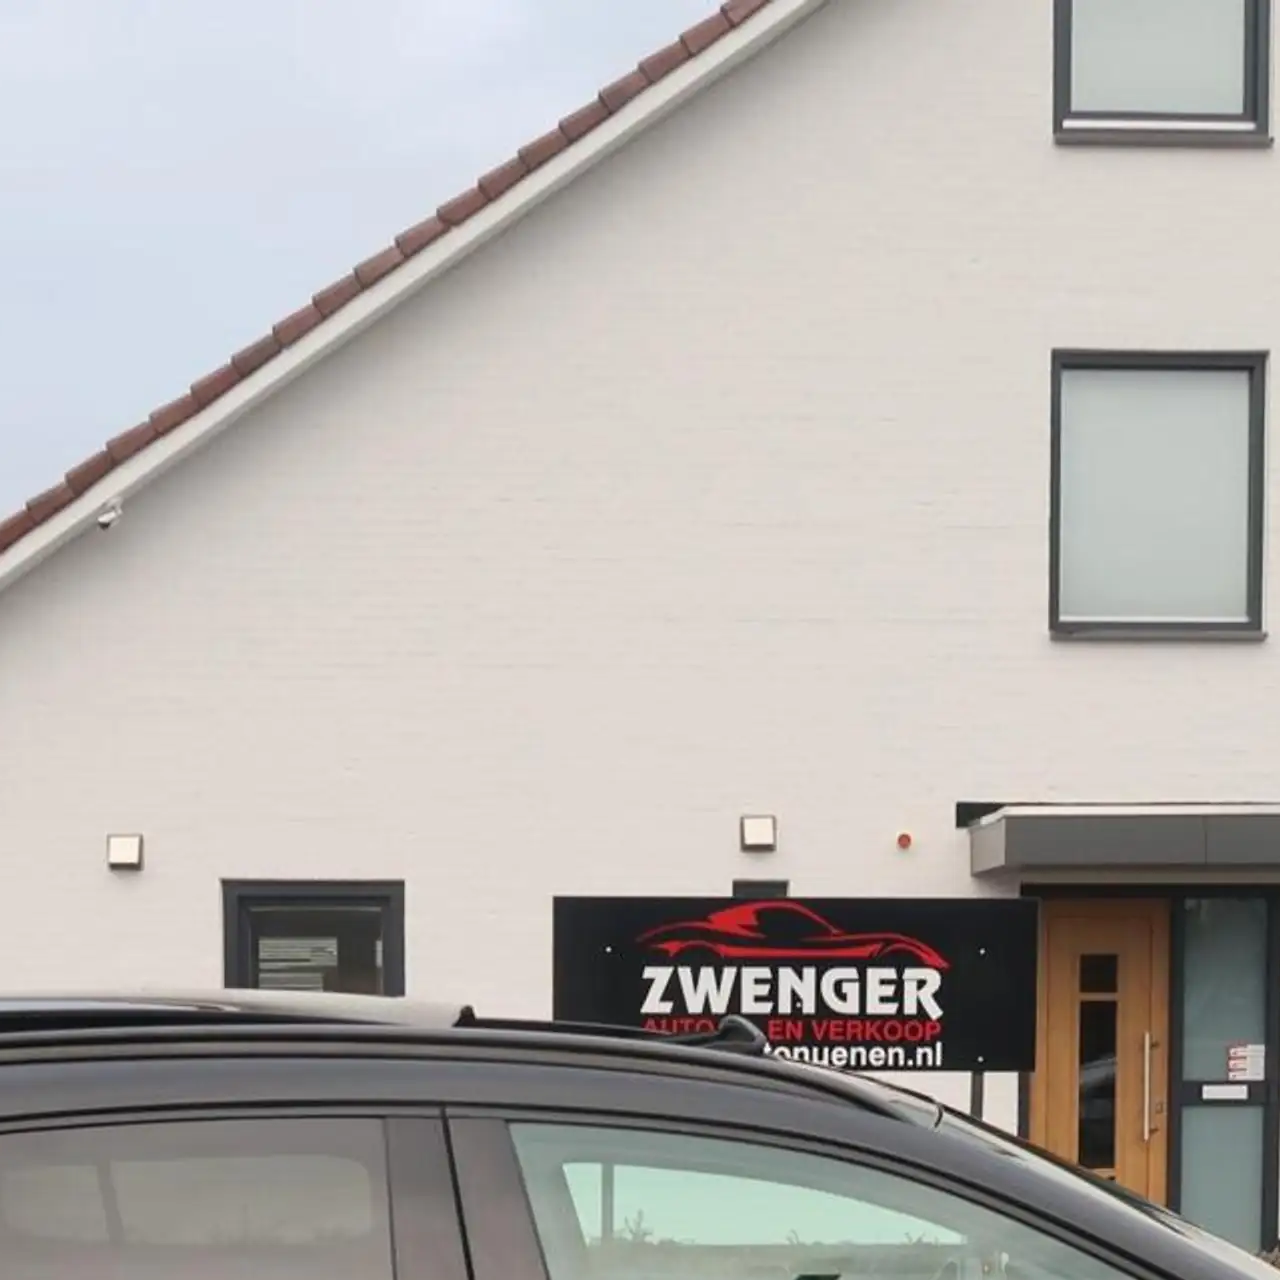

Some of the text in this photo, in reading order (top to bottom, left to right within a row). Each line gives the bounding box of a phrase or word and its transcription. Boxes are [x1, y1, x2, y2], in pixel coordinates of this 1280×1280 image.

[640, 966, 944, 1020] ZWENGER
[767, 1018, 803, 1041] EN
[811, 1018, 942, 1041] VERKOOP
